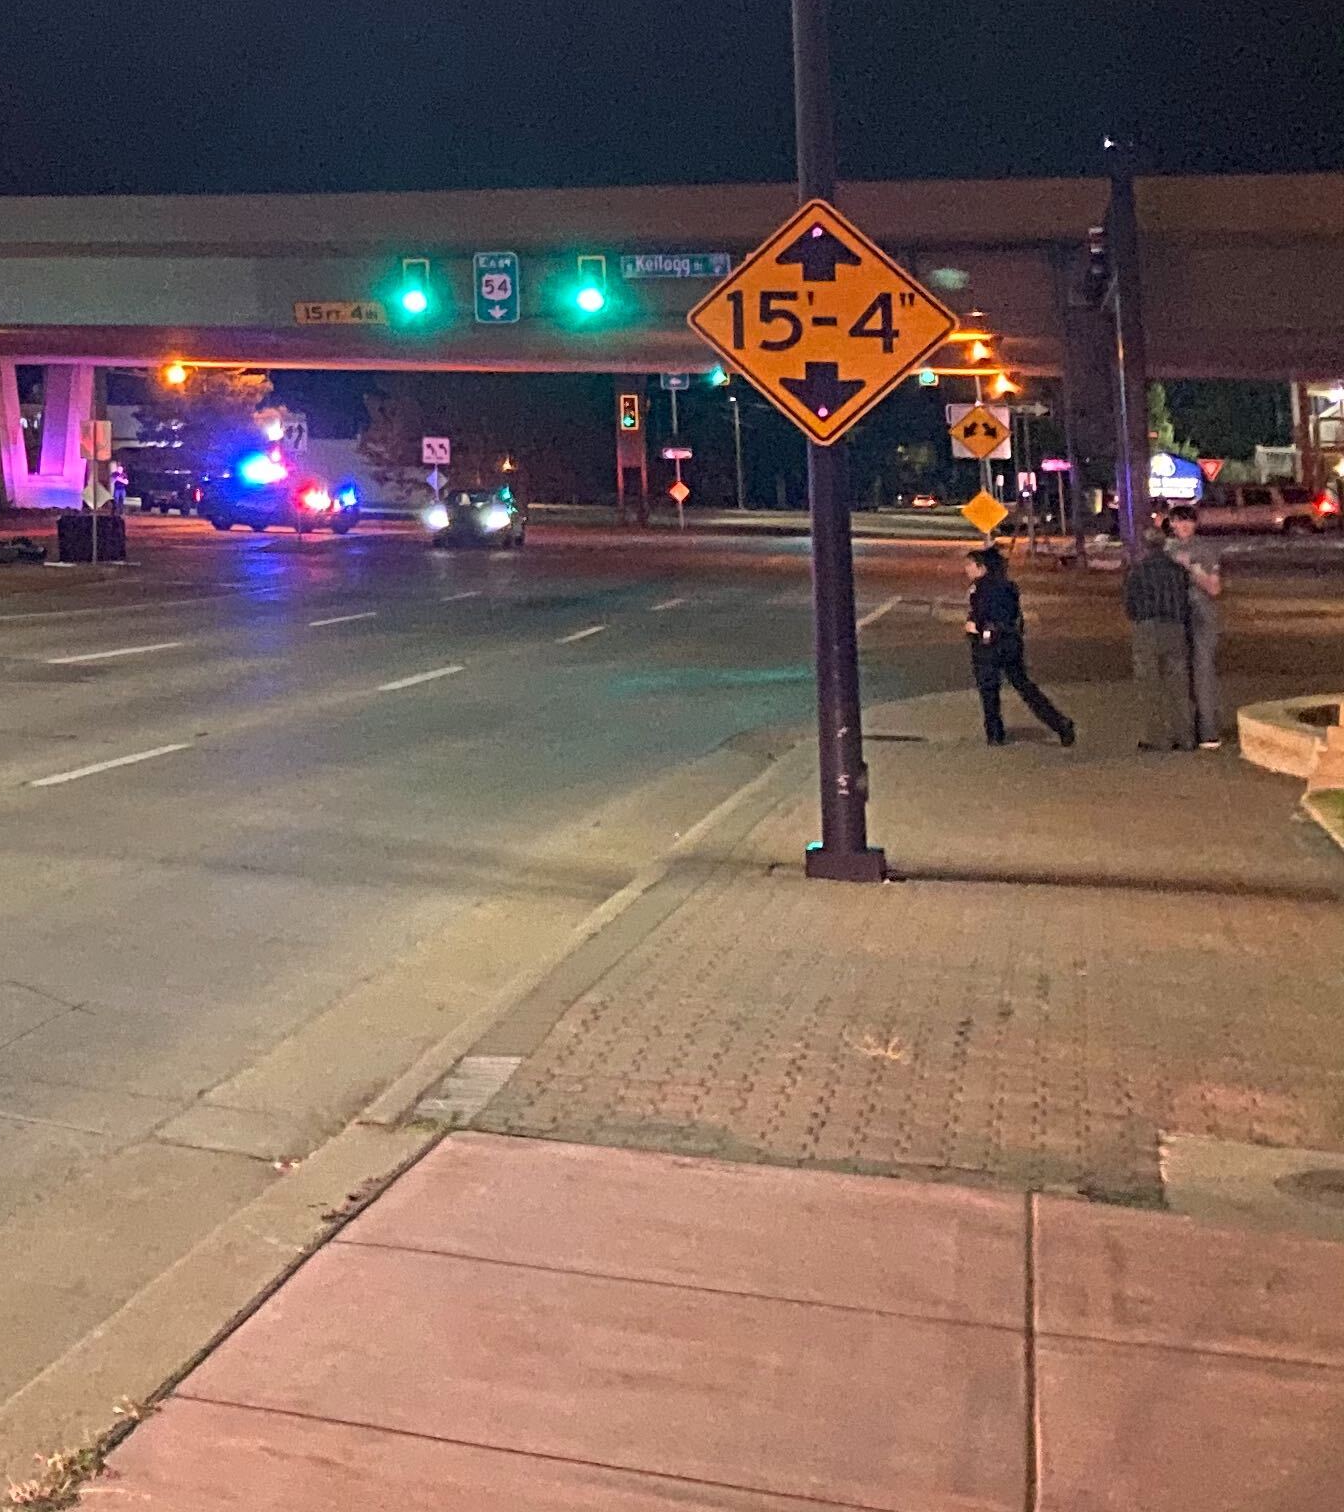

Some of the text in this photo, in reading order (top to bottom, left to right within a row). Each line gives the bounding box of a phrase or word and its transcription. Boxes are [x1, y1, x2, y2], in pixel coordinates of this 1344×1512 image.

[634, 254, 691, 278] Kellogg
[484, 278, 509, 296] 54
[304, 305, 323, 320] 15
[350, 305, 363, 321] 4
